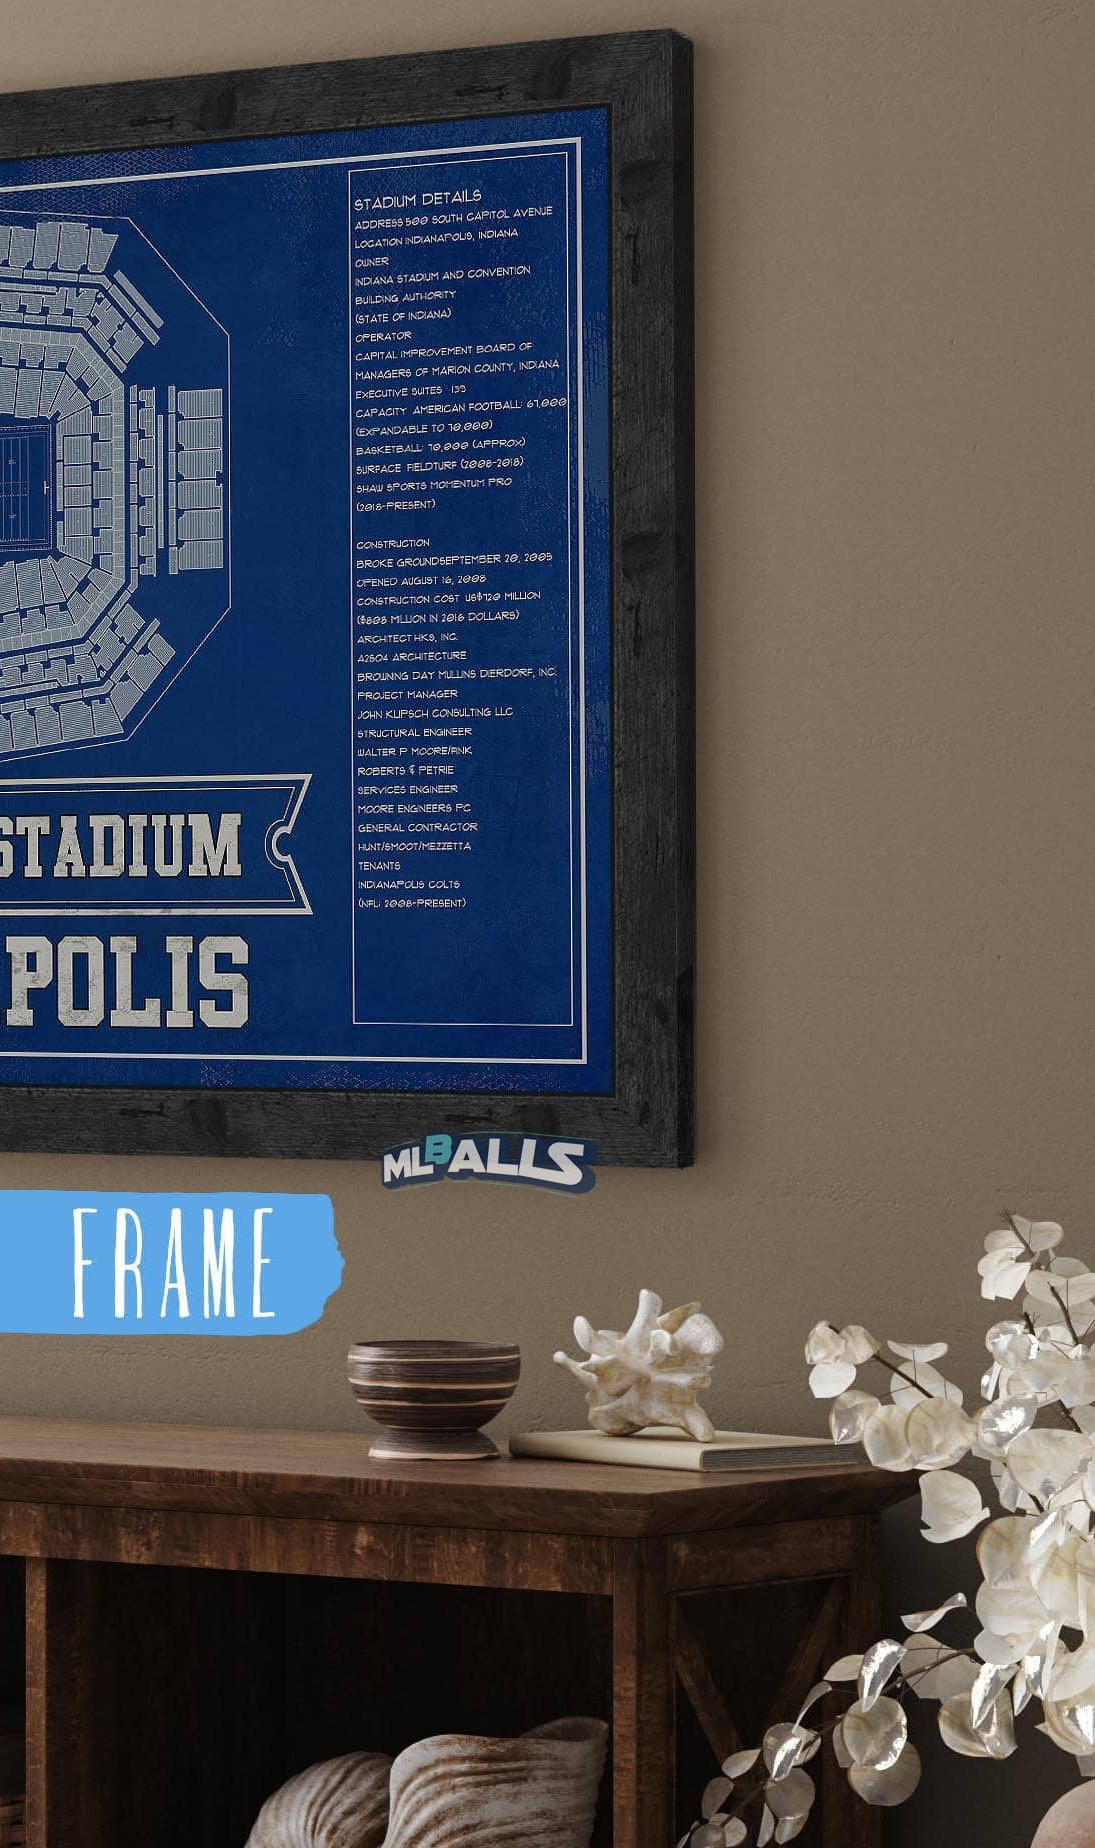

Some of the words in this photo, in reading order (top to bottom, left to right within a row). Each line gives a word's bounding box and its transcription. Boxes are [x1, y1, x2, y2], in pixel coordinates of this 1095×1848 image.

[355, 195, 416, 210] STADIUM
[422, 190, 481, 205] DETAILS
[355, 220, 403, 230] ADDRESS
[405, 217, 428, 226] 500
[432, 214, 463, 224] SOUTH
[467, 209, 510, 221] CAPITOL
[513, 206, 553, 217] AVENUE
[355, 237, 402, 249] LOCATION
[405, 232, 475, 245] INDIANAPOLIS,
[478, 229, 518, 239] INDIANA
[355, 257, 389, 267] OWNER
[355, 276, 394, 286] INDIANA
[396, 273, 438, 284] STADIUM
[442, 271, 464, 279] AND
[467, 265, 530, 278] CONVENTION
[356, 295, 398, 304] BUILDING
[402, 290, 456, 301] AUTHORITY
[356, 314, 388, 324] (STATE
[392, 312, 405, 321] OF
[408, 308, 452, 320] INDIANA)
[355, 331, 412, 343] OPERATOR
[356, 351, 398, 361] CAPITAL
[401, 346, 473, 358] IMPROVEMENT
[477, 343, 516, 353] BOARD
[356, 369, 412, 380] MANAGERS
[416, 368, 429, 377] OF
[432, 365, 471, 376] MARION
[474, 363, 516, 373] COUNTY,
[519, 359, 559, 370] INDIANA
[356, 388, 408, 399] EXECUTIVE
[411, 386, 442, 396] SUITES
[356, 408, 407, 417] CAPACITY
[413, 403, 465, 414] AMERICAN
[469, 401, 523, 411] FOOTBALL:
[356, 425, 428, 436] (EXPANDABLE
[431, 424, 444, 432] TO
[448, 420, 493, 431] 70,000)
[428, 441, 469, 452] 70,000
[472, 437, 526, 449] (APPROX)
[356, 464, 401, 474] SURFACE
[460, 456, 524, 470] (2008-2018)
[356, 484, 383, 494] SHAW
[386, 482, 426, 492] SPORTS
[430, 479, 485, 489] MOMENTUM
[489, 478, 512, 486] PRO
[357, 539, 430, 549] CONSTRUCTION
[357, 558, 393, 568] BROKE
[505, 554, 520, 563] 20,
[525, 553, 553, 562] 2005
[357, 578, 397, 587] OPENED
[401, 576, 437, 586] AUGUST
[458, 574, 487, 583] 2008
[357, 595, 430, 606] CONSTRUCTION
[434, 594, 459, 603] COST
[504, 591, 541, 600] MILLION
[390, 614, 426, 623] MILLION
[429, 614, 438, 622] IN
[441, 613, 465, 622] 2016
[468, 610, 519, 621] DOLLARS)
[357, 634, 413, 643] ARCHITECT
[414, 633, 437, 642] HKS,
[393, 651, 467, 661] ARCHITECTURE
[357, 672, 409, 682] BROWNING
[413, 671, 435, 680] DAY
[480, 668, 535, 678] DIERDORF,
[357, 691, 403, 700] PROJECT
[407, 690, 457, 699] MANAGER
[357, 710, 383, 720] JOHN
[432, 708, 491, 718] CONSULTING
[495, 707, 513, 716] LLC
[357, 729, 420, 738] STRUCTURAL
[423, 727, 472, 737] ENGINEER
[357, 748, 396, 757] WALTER
[357, 767, 405, 776] ROBERTS
[419, 766, 454, 775] PETRIE
[357, 786, 406, 795] SERVICES
[409, 785, 458, 794] ENGINEER
[358, 805, 394, 814] MOORE
[397, 804, 452, 813] ENGINEERS
[456, 804, 471, 812] PC
[358, 824, 405, 833] GENERAL
[408, 822, 478, 832] CONTRACTOR
[358, 842, 472, 852] HUNT/SMOOT/MEZZETTA
[359, 861, 401, 871] TENANTS
[359, 880, 424, 889] INDIANAPOLIS
[428, 880, 460, 889] COLTS
[384, 898, 467, 908] 2008-PRESENT)
